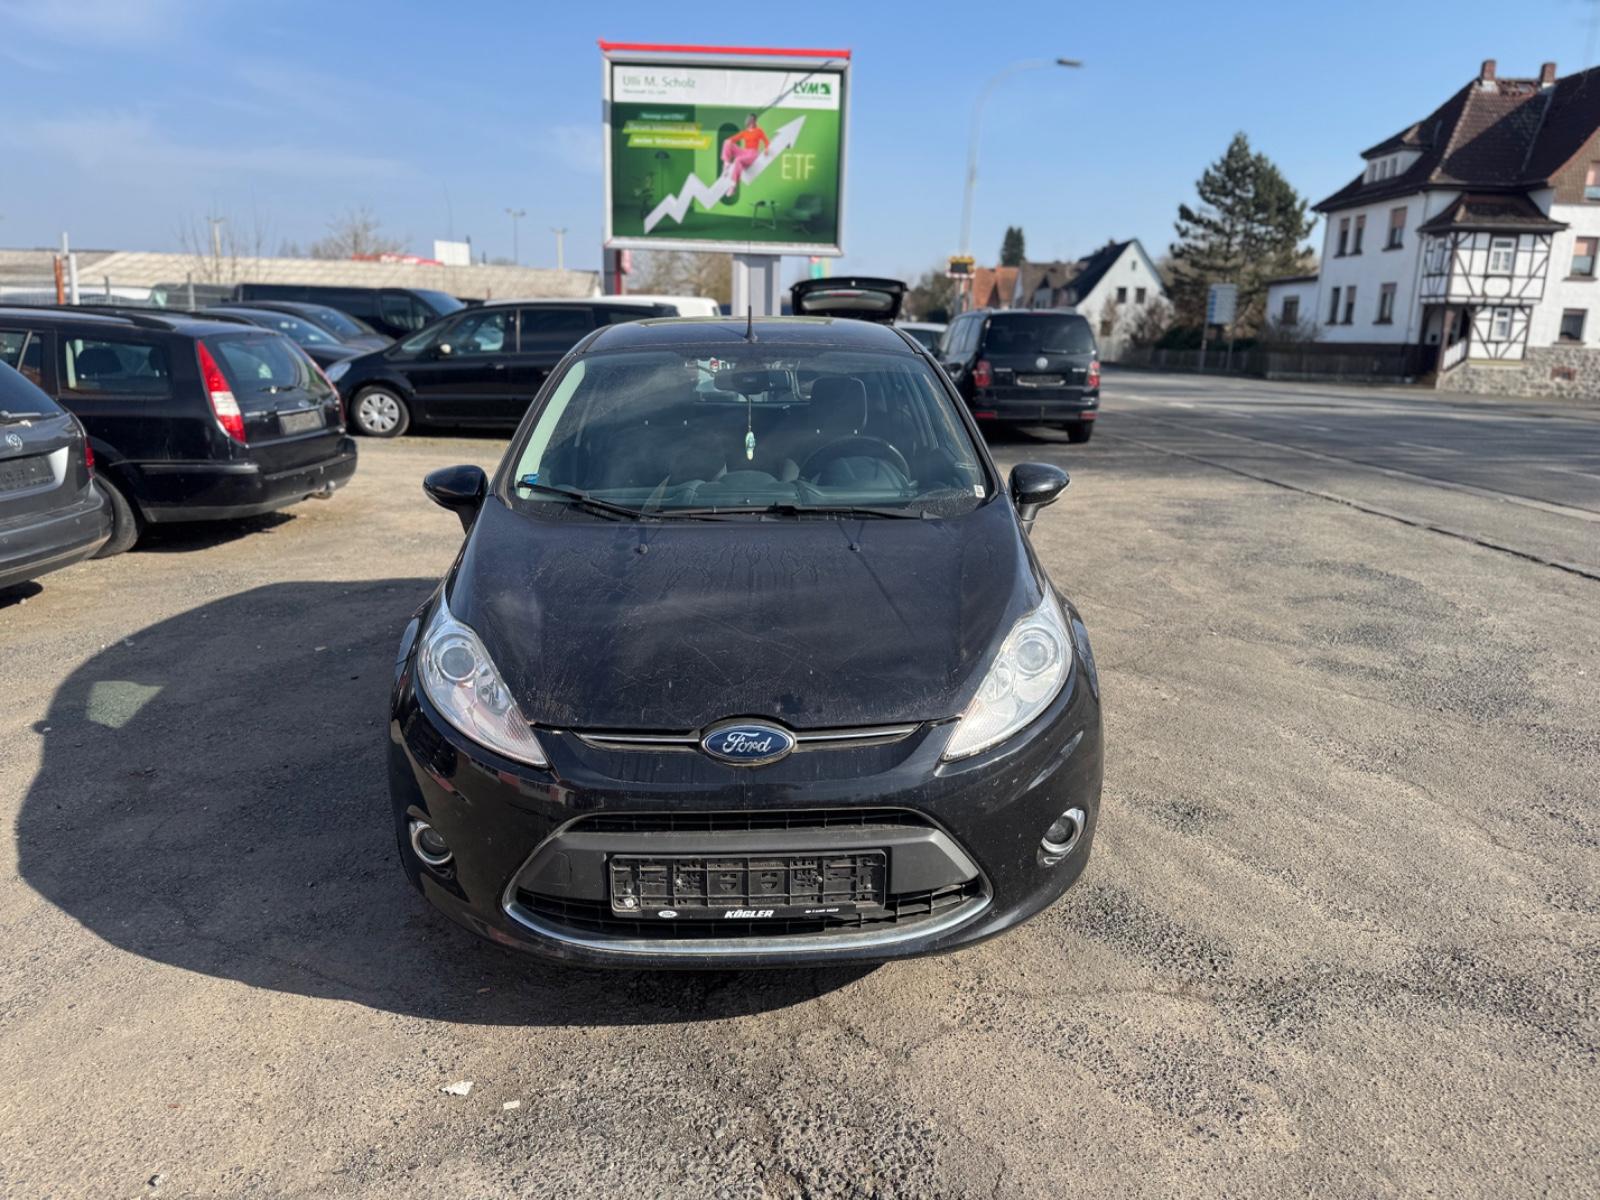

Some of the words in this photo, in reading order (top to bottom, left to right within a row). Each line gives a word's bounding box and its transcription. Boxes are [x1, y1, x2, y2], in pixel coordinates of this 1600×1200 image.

[661, 77, 696, 88] Scholz
[793, 82, 818, 94] LVM
[782, 154, 816, 180] ETF
[722, 731, 772, 753] Ford
[724, 909, 774, 919] KÖGLER
